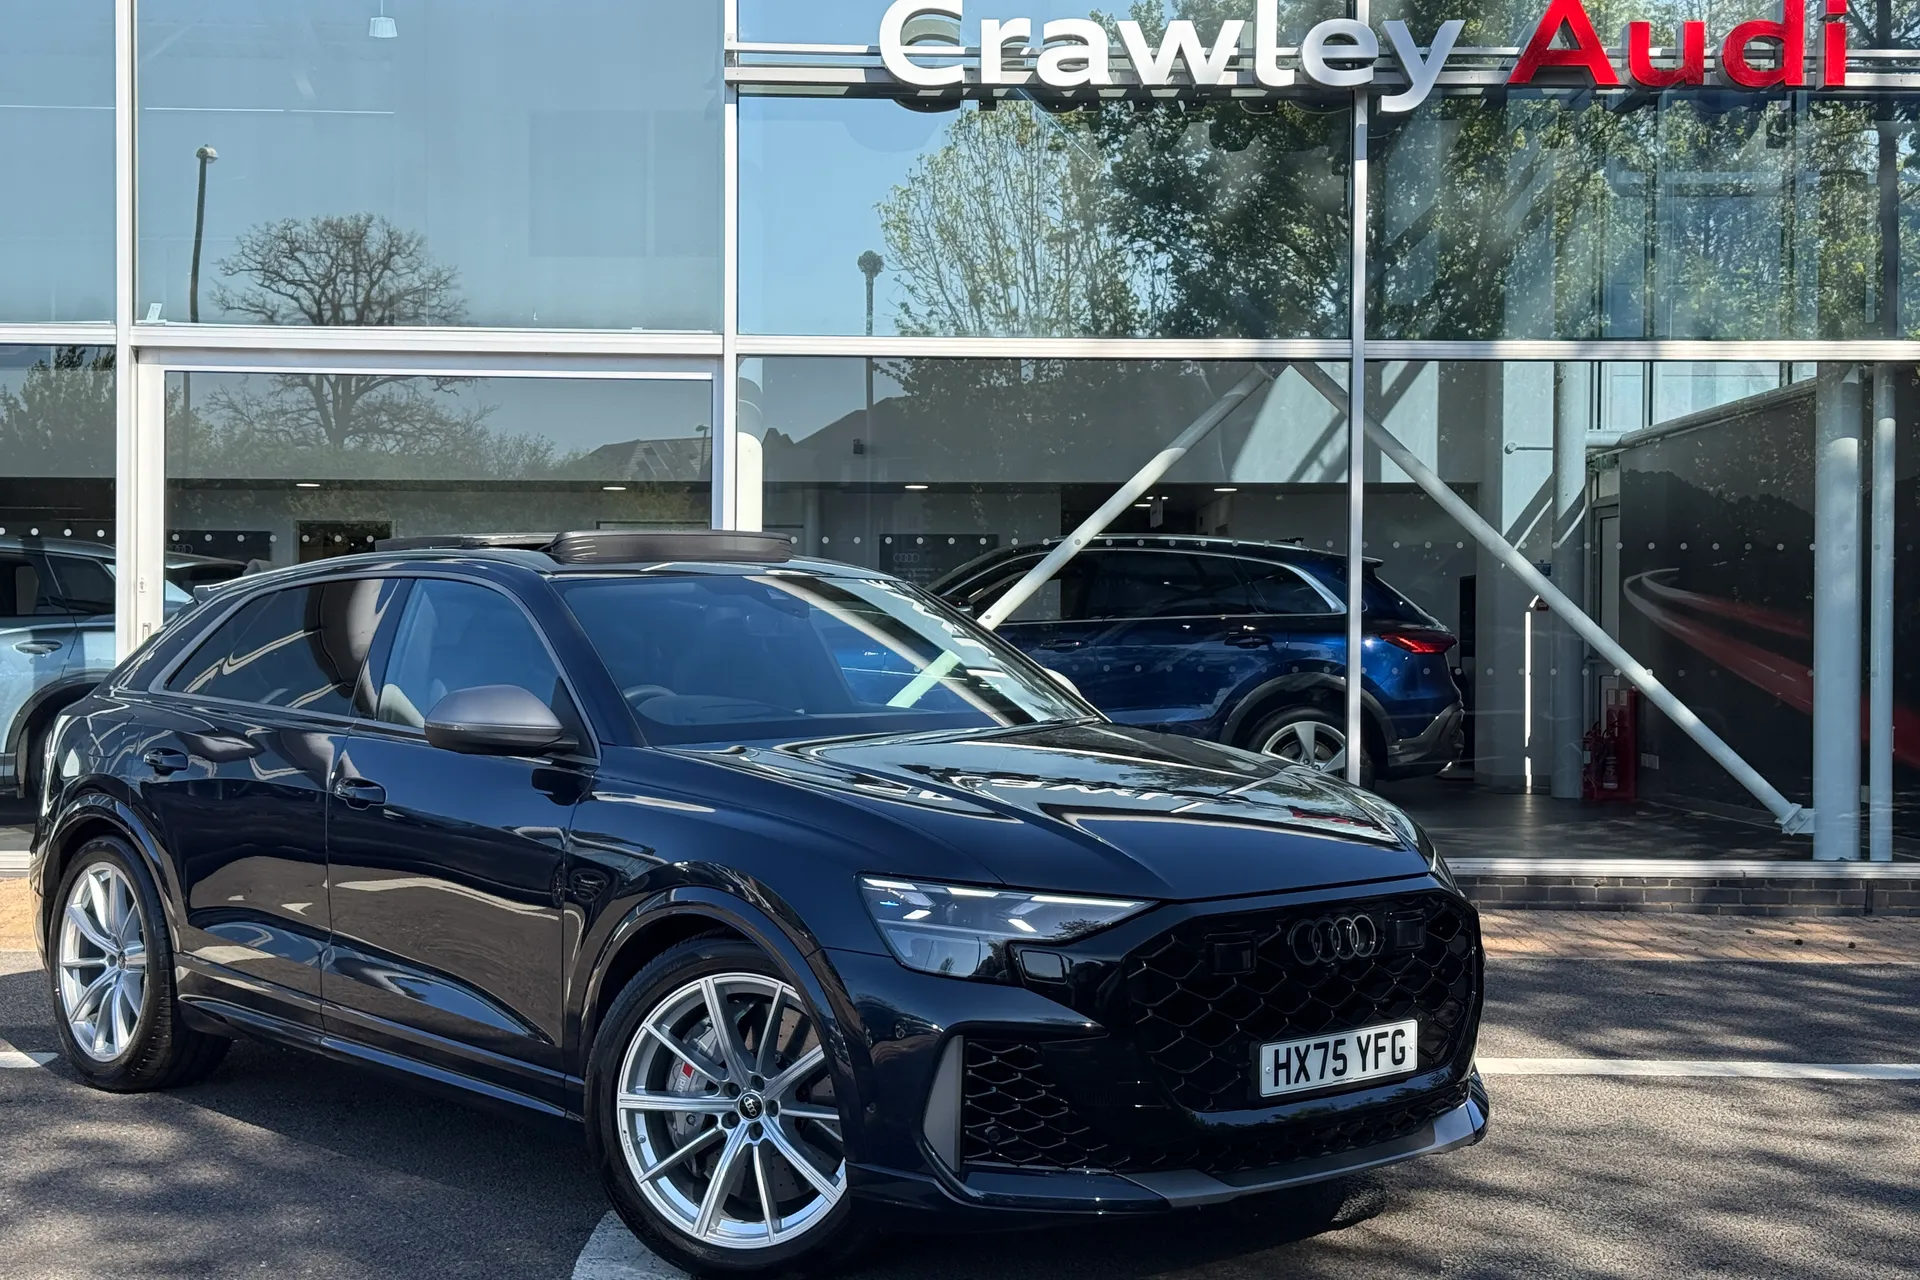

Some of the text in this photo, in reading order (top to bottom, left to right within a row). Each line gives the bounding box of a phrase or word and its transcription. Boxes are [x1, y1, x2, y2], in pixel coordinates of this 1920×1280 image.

[879, 0, 1847, 112] Crawley Audi
[677, 1075, 687, 1092] udi
[1274, 1028, 1406, 1087] HX75 YFG
